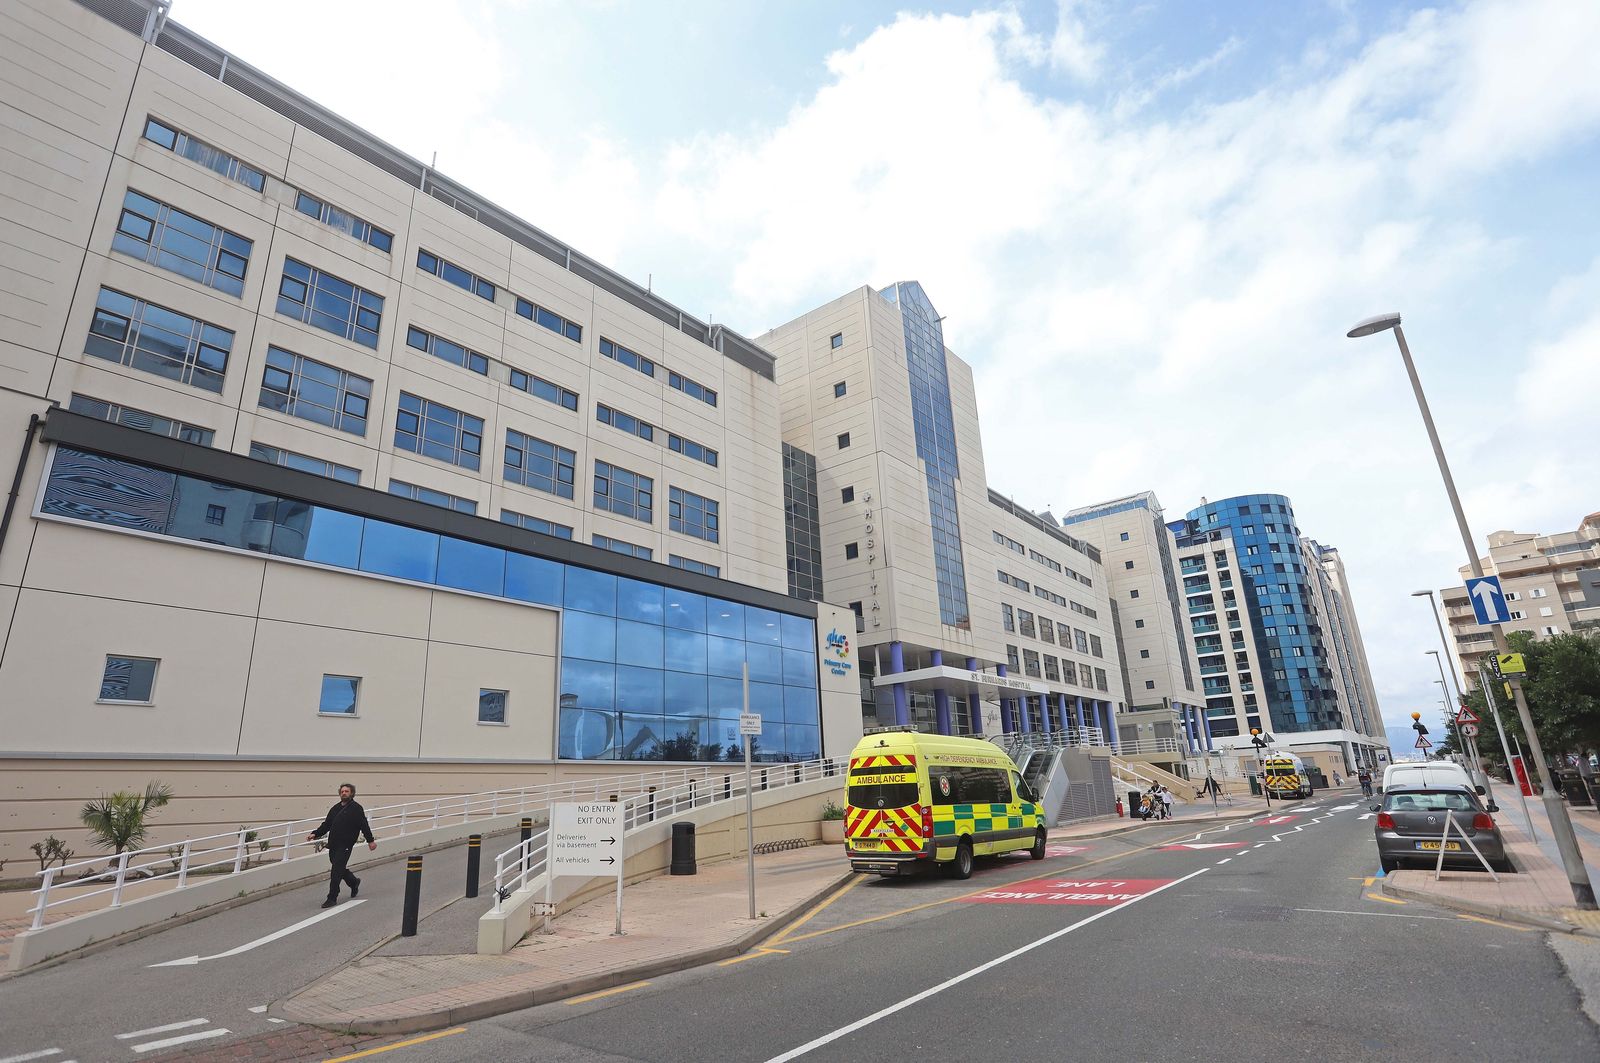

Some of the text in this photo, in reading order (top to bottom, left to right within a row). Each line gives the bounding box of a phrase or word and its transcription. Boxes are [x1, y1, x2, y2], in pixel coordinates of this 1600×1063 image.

[1490, 656, 1501, 678] CCTV
[856, 774, 906, 784] AMBULANCE
[974, 892, 1140, 900] AMBULANCE
